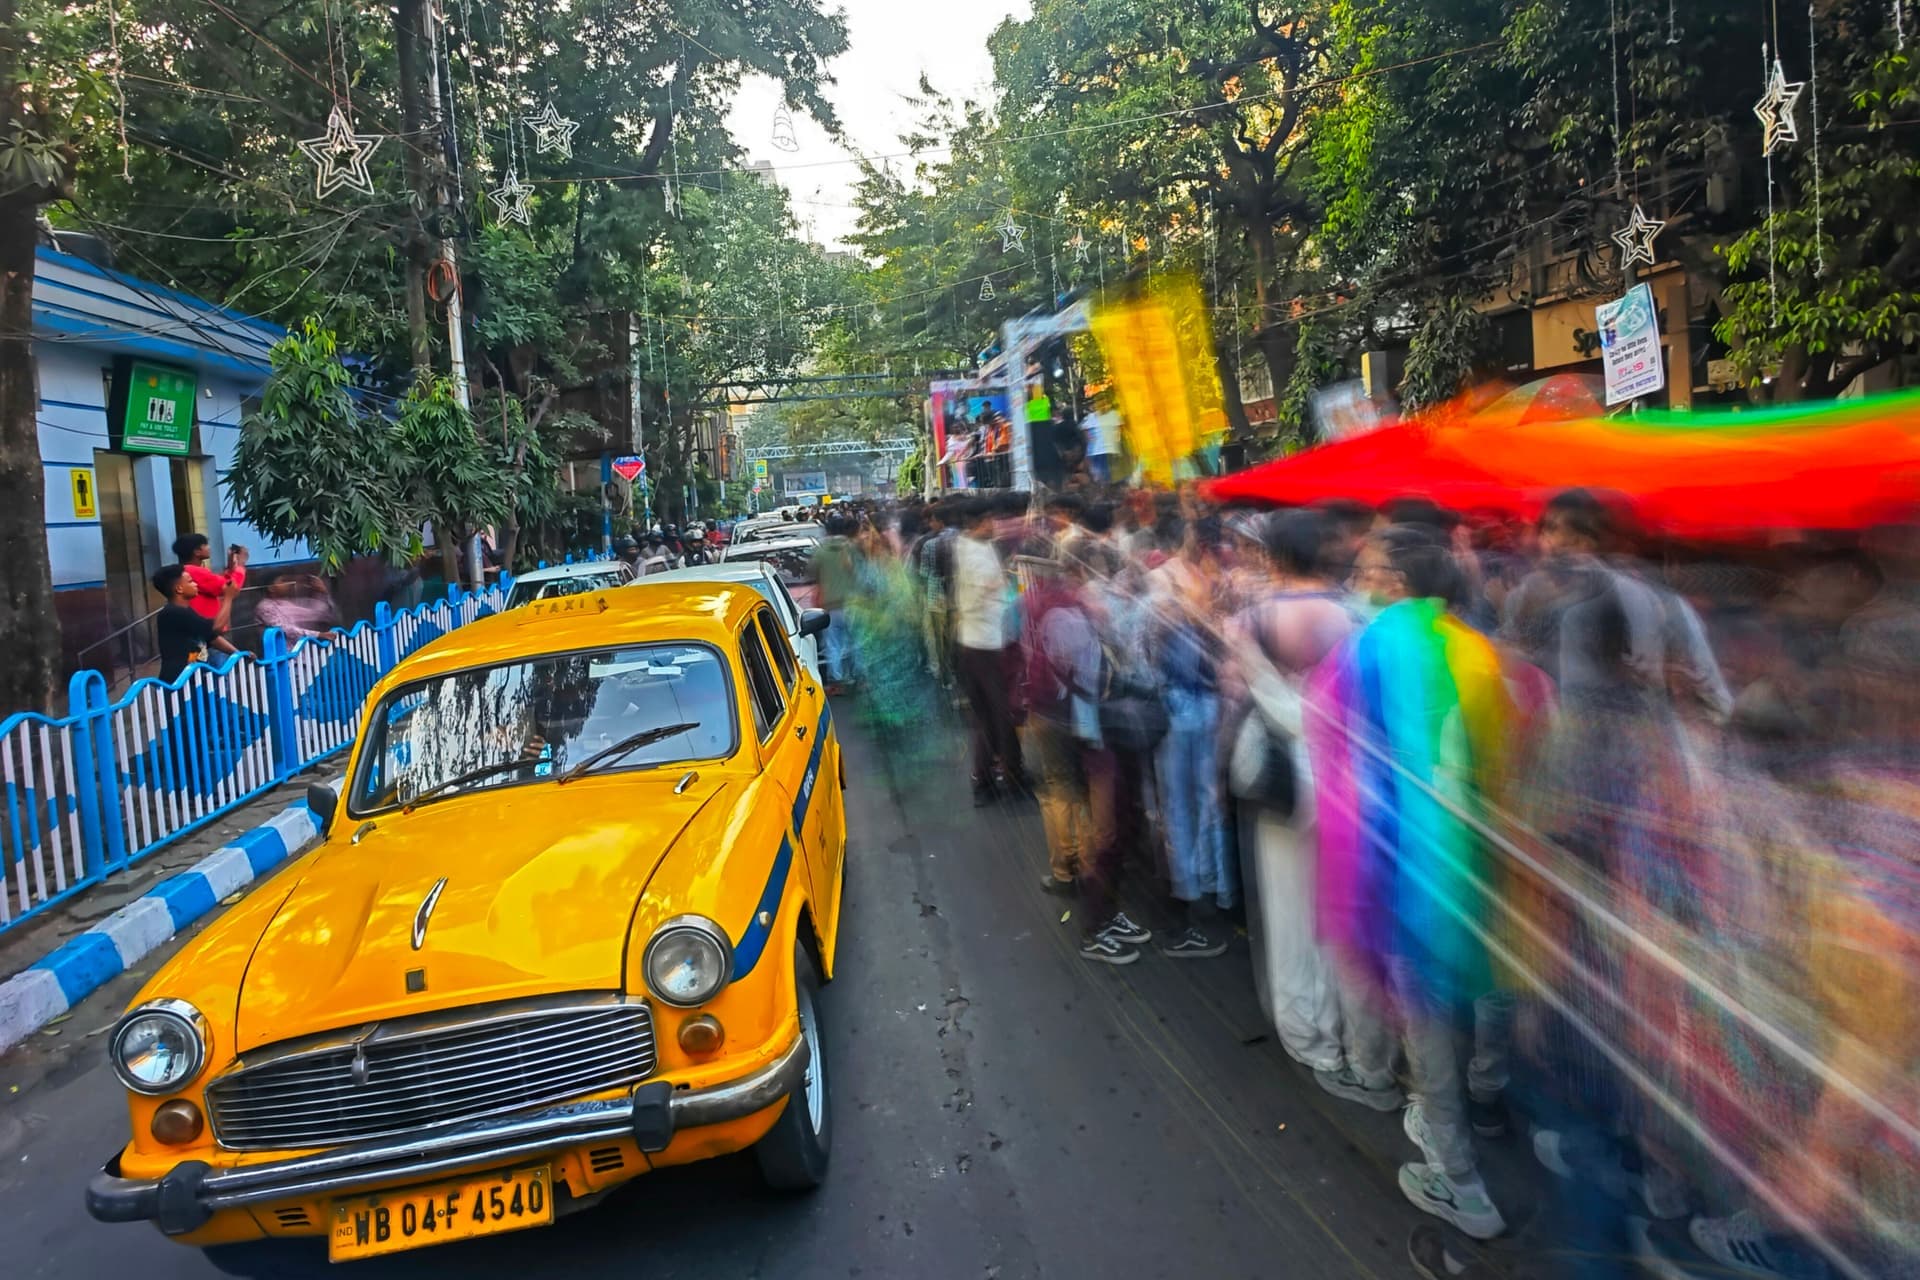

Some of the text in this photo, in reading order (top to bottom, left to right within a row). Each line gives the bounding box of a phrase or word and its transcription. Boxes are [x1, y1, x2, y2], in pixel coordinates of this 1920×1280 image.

[534, 598, 585, 615] TAXI
[355, 1207, 391, 1246] WB
[472, 1180, 544, 1224] 4540
[336, 1226, 353, 1237] IND
